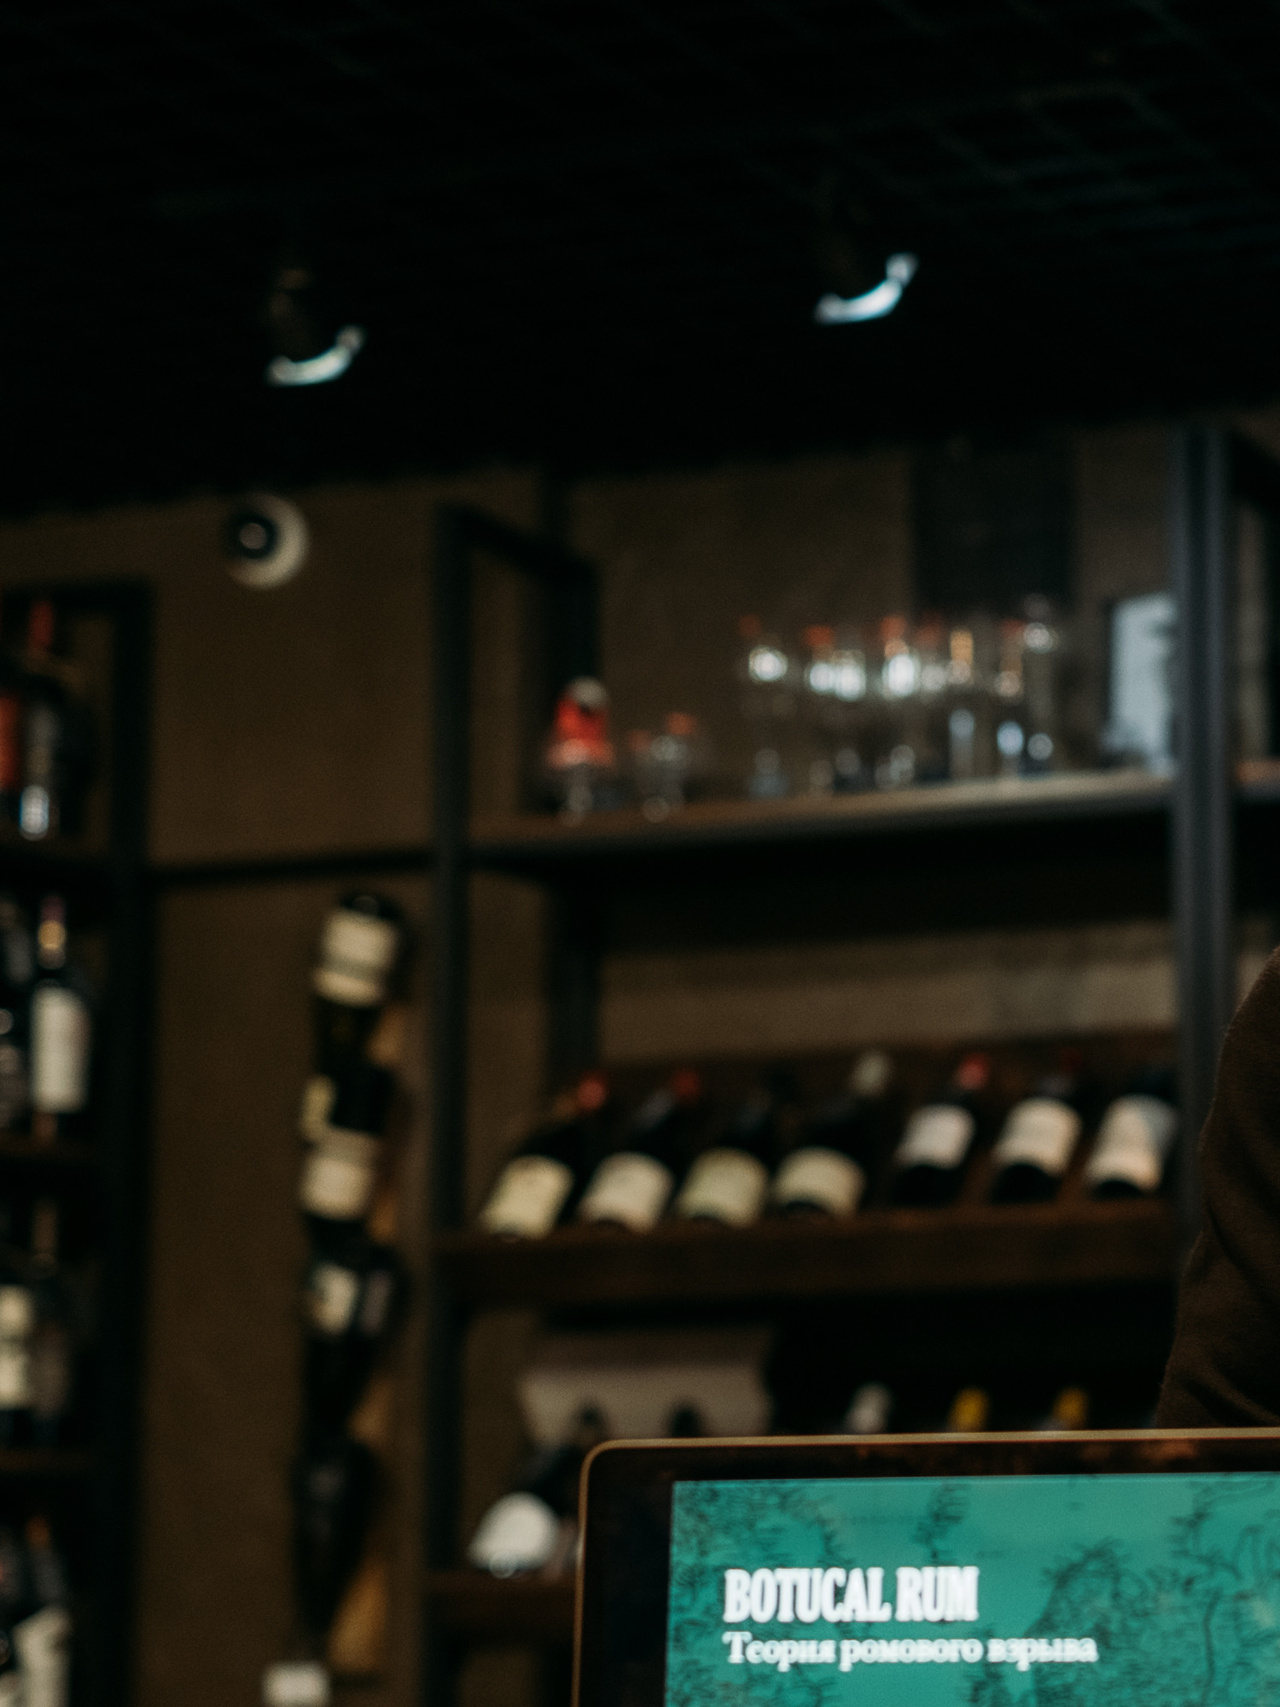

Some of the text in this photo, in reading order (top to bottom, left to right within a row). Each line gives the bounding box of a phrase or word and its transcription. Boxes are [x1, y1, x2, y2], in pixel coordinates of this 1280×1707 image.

[722, 1565, 980, 1623] BOTUCAL RUM
[721, 1630, 1099, 1672] Теория ромового взрыва
